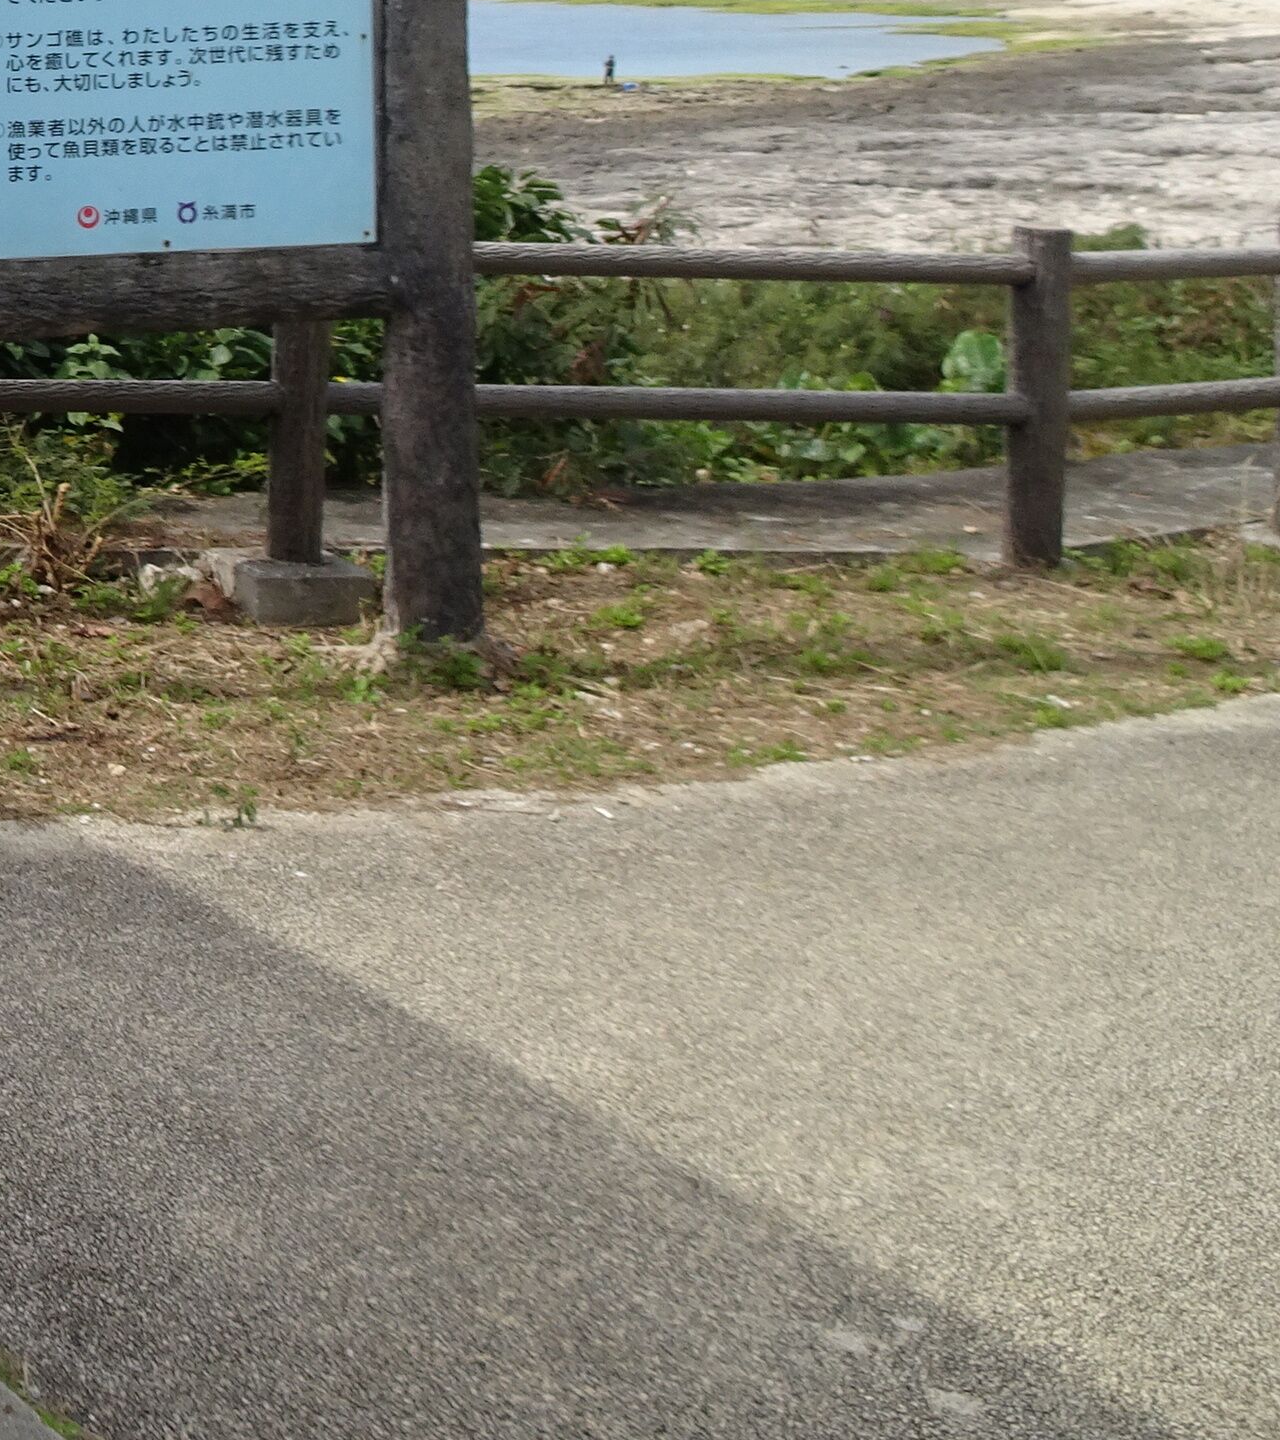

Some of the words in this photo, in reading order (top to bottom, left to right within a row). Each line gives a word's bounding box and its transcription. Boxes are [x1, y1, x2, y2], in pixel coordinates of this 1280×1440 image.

[6, 43, 339, 71] 心を癒してくれます。次世代に残すため
[6, 71, 201, 94] にも、大切にしましょう。
[7, 131, 342, 160] 使って魚貝類を取ることは禁止されてい
[8, 165, 53, 184] ます。
[104, 206, 158, 225] 沖縄県
[202, 203, 256, 221] 糸満市
